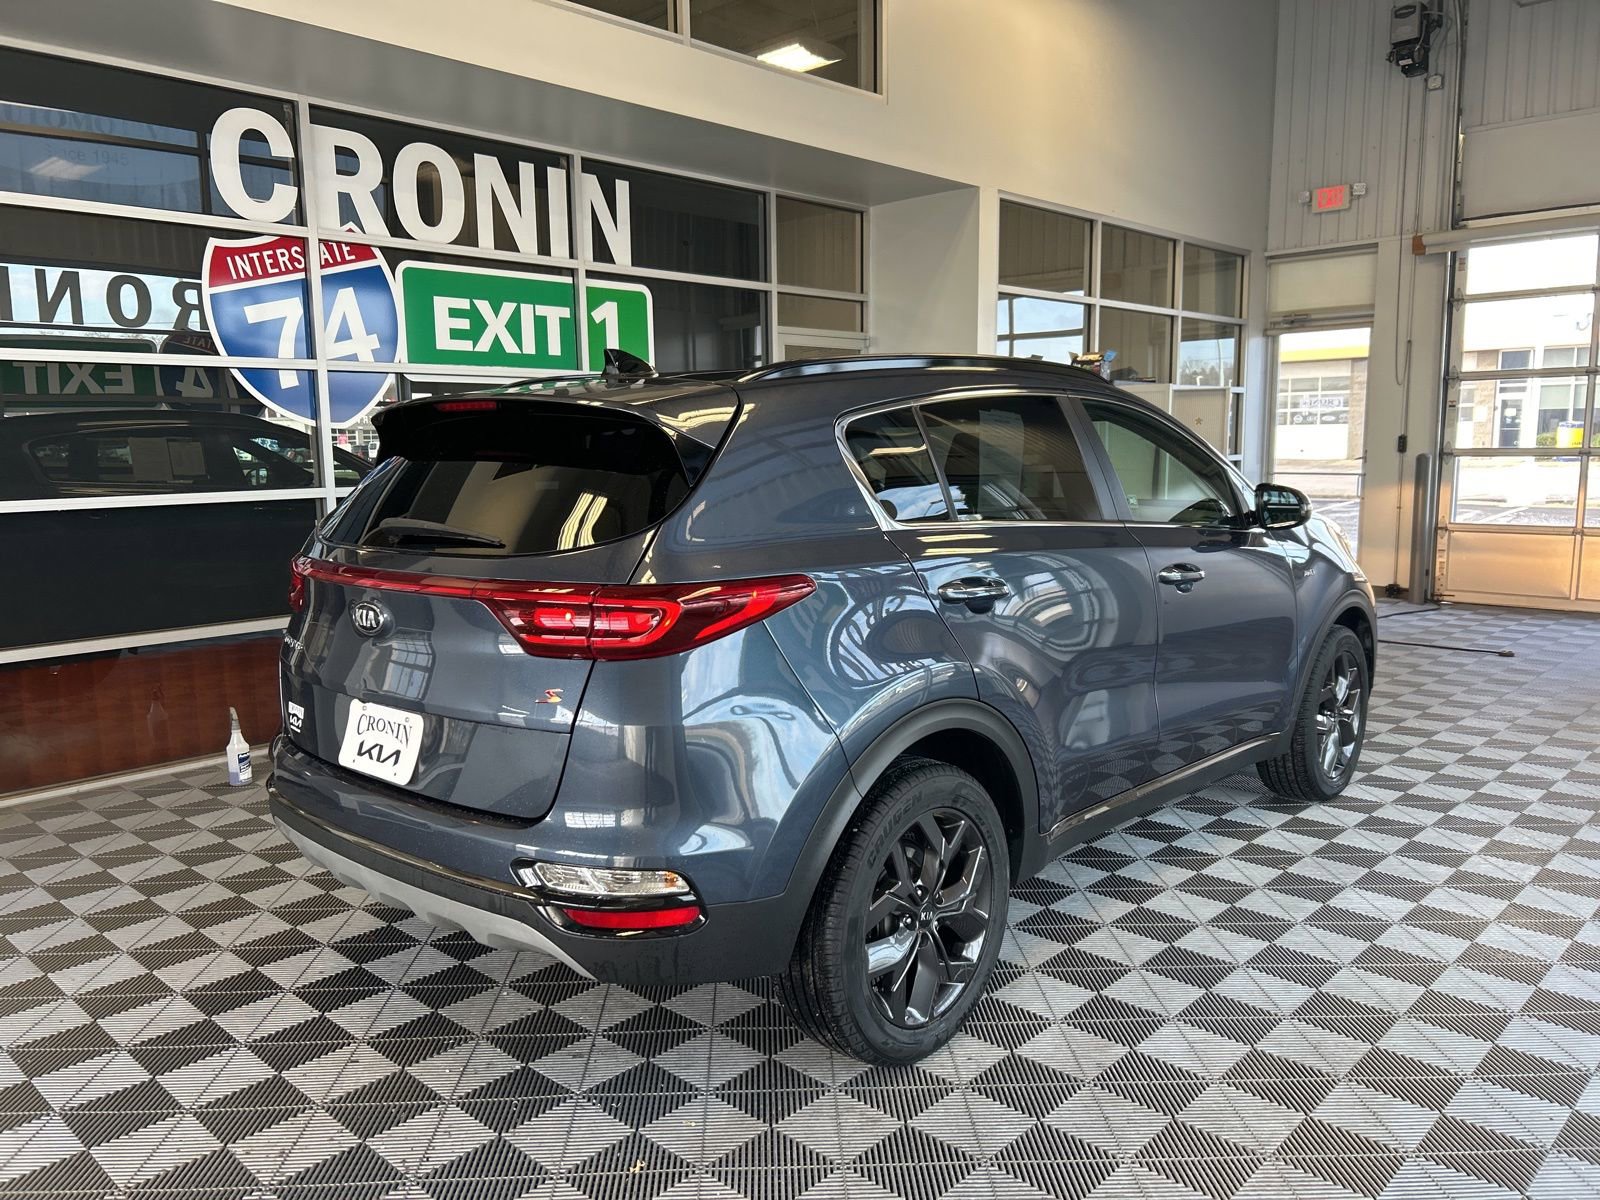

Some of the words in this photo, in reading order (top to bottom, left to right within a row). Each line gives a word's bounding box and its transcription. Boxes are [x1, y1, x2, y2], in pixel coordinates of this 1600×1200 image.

[210, 107, 632, 267] CRONIN
[226, 242, 357, 280] INTERSATE
[244, 287, 380, 390] 74
[433, 295, 570, 356] EXIT
[590, 301, 620, 352] 1
[355, 608, 377, 628] KIA
[357, 713, 412, 750] CRONIN
[357, 740, 401, 767] KIA
[920, 911, 934, 921] KIA
